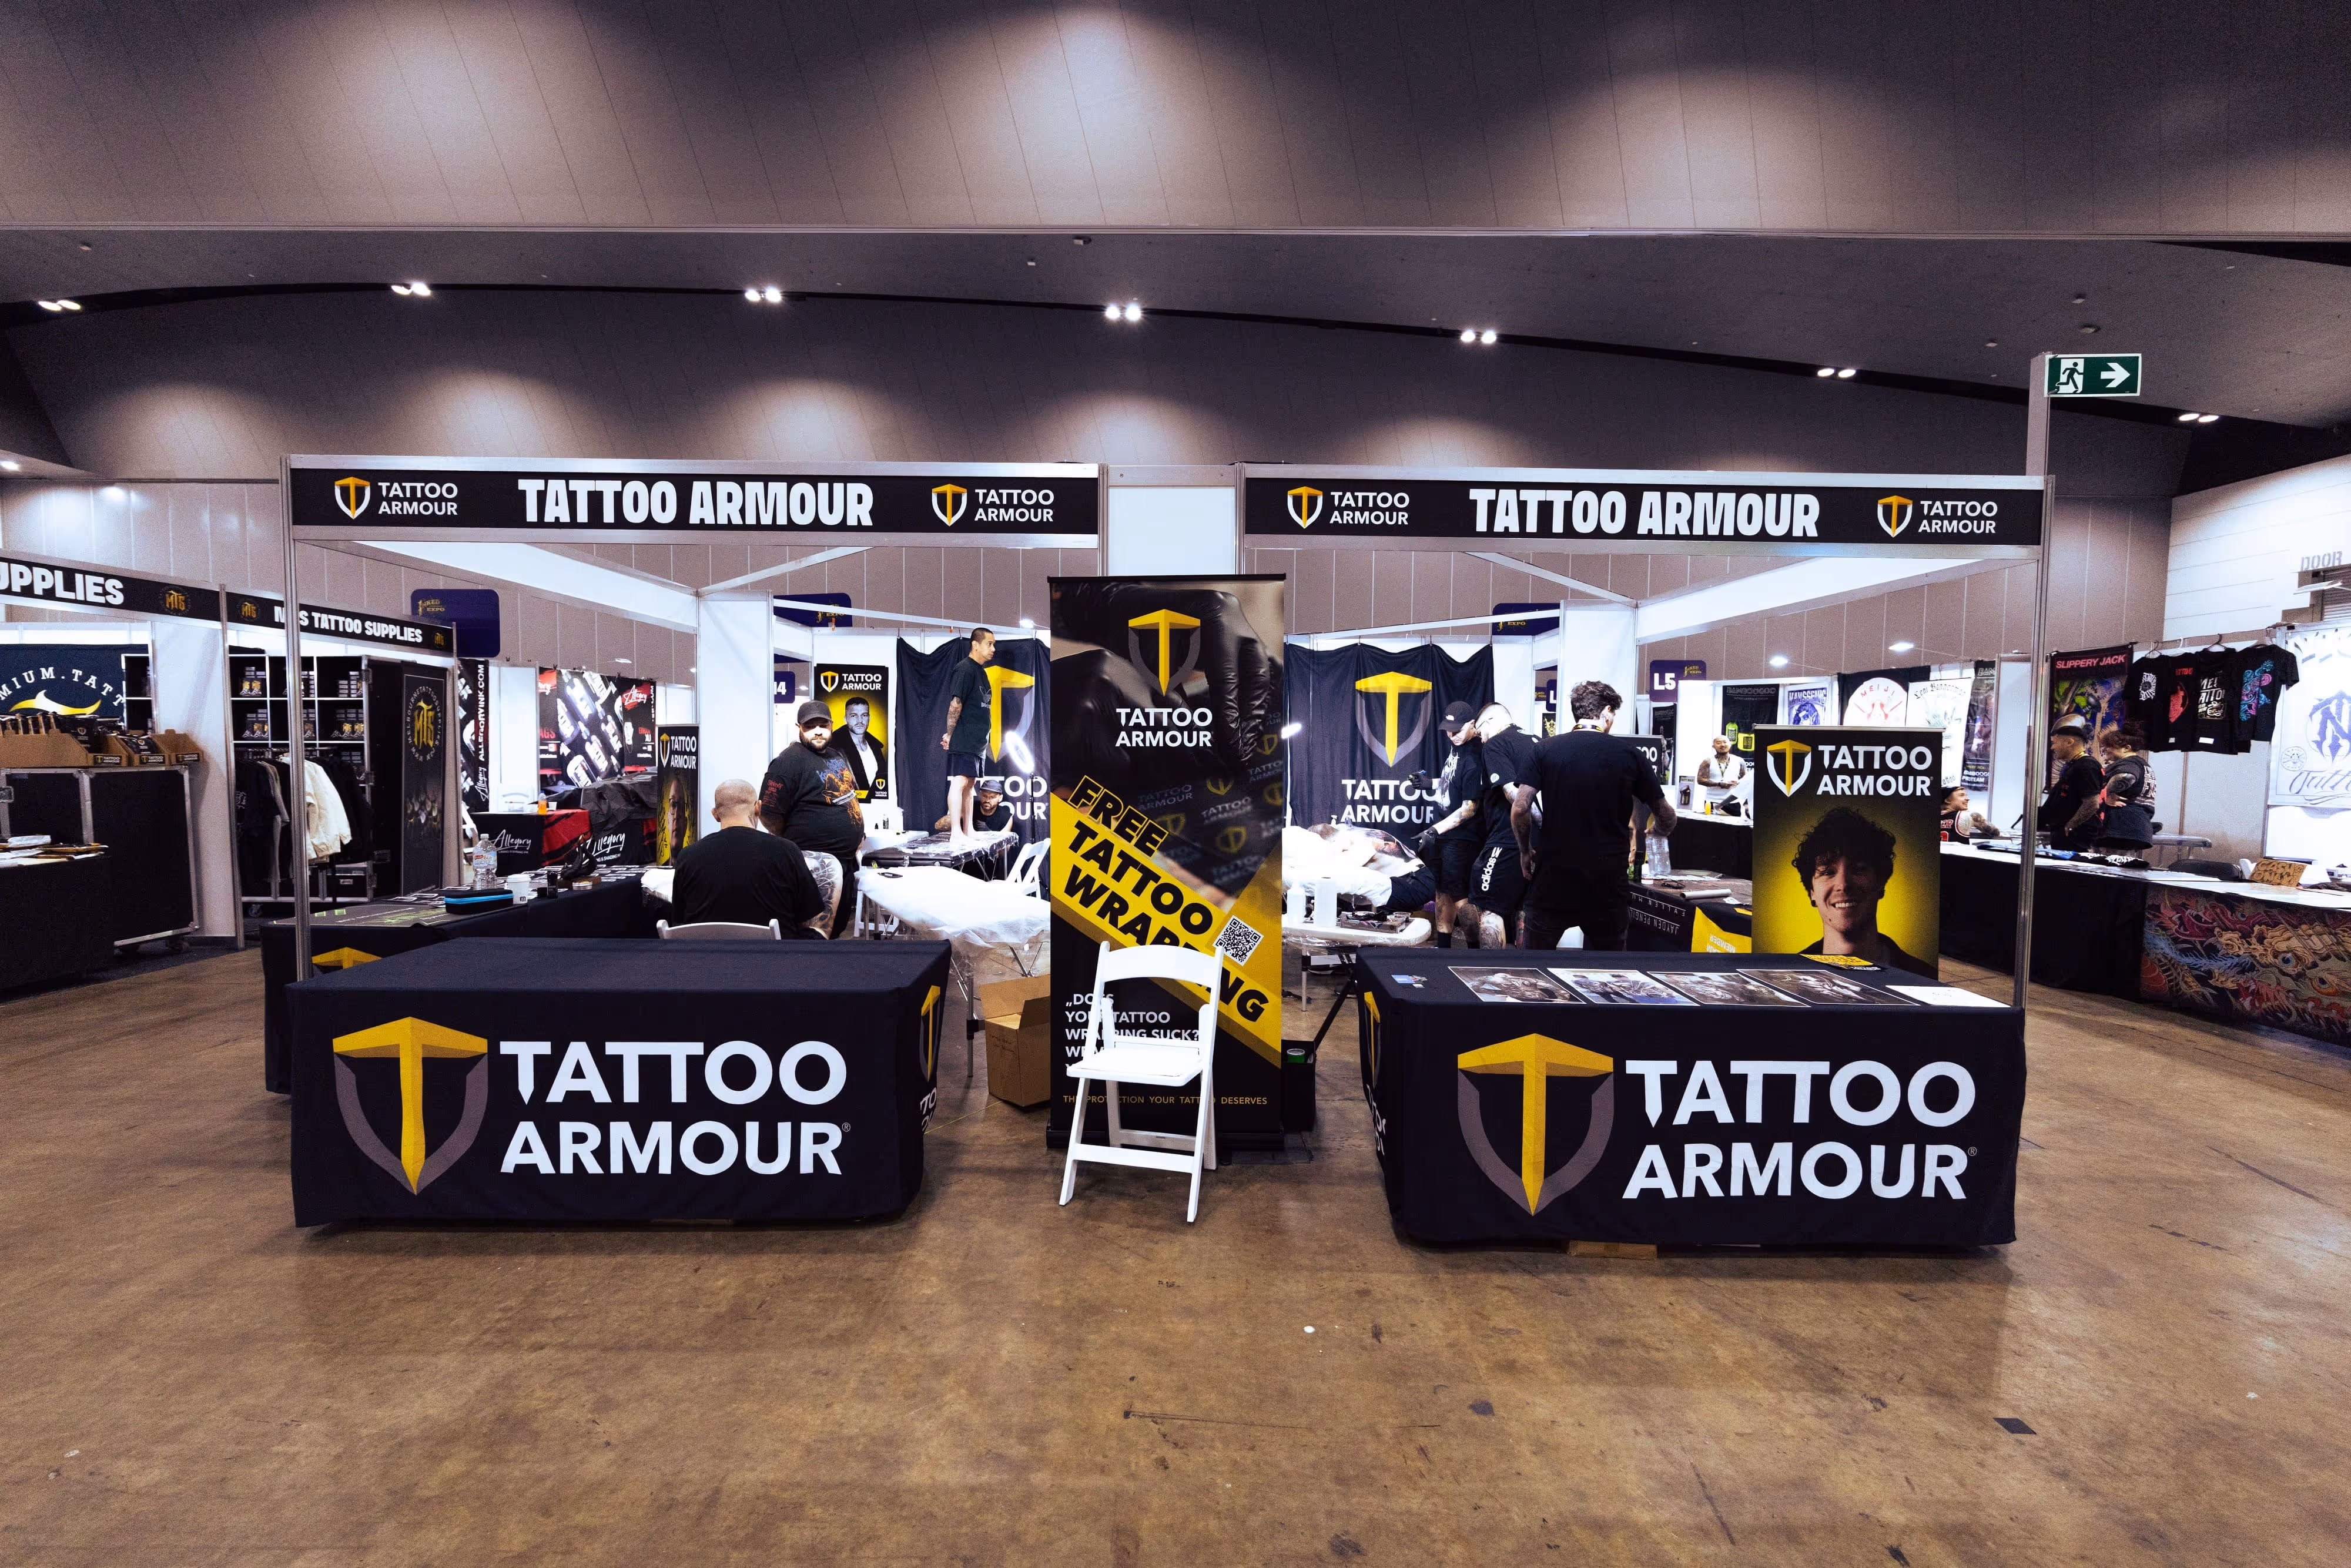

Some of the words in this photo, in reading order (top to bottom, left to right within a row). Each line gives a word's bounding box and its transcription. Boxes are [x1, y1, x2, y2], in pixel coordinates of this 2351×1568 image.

[378, 481, 458, 499] TATTOO
[974, 489, 1054, 505] TATTOO
[378, 502, 458, 515] ARMOUR
[518, 479, 677, 523] TATTOO
[689, 480, 873, 526] ARMOUR
[1330, 491, 1409, 508] TATTOO
[1919, 500, 1998, 517] TATTOO
[974, 508, 1054, 522] ARMOUR
[1329, 511, 1409, 525] ARMOUR
[1469, 488, 1626, 534] TATTOO
[1637, 491, 1820, 537] ARMOUR
[1918, 520, 1996, 533] ARMOUR
[2300, 551, 2342, 571] DOOR
[312, 612, 362, 634] TATTOO
[364, 623, 423, 644] SUPPLIES
[2056, 658, 2098, 669] SLIPPERY
[2099, 654, 2126, 666] JACK
[842, 674, 882, 682] TATTOO
[1653, 672, 1676, 691] L5
[1116, 708, 1213, 727] TATTOO
[670, 736, 696, 752] TATTOO
[1115, 731, 1213, 748] ARMOUR
[670, 755, 696, 769] ARMOUR
[1818, 745, 1933, 770] TATTOO
[1067, 775, 1170, 860] FREE
[490, 829, 532, 852] Allegory
[1068, 820, 1213, 935] TATTOO
[1481, 857, 1496, 892] adidas
[1653, 918, 1680, 936] JAYDEN
[1709, 933, 1736, 953] MEMBER
[1113, 1011, 1171, 1023] TATTOO
[500, 1040, 847, 1105] TATTOO
[1063, 1095, 1079, 1104] TH
[1149, 1095, 1175, 1104] YOUR
[1221, 1096, 1268, 1105] DESERVES
[1626, 1060, 1976, 1128] TATTOO
